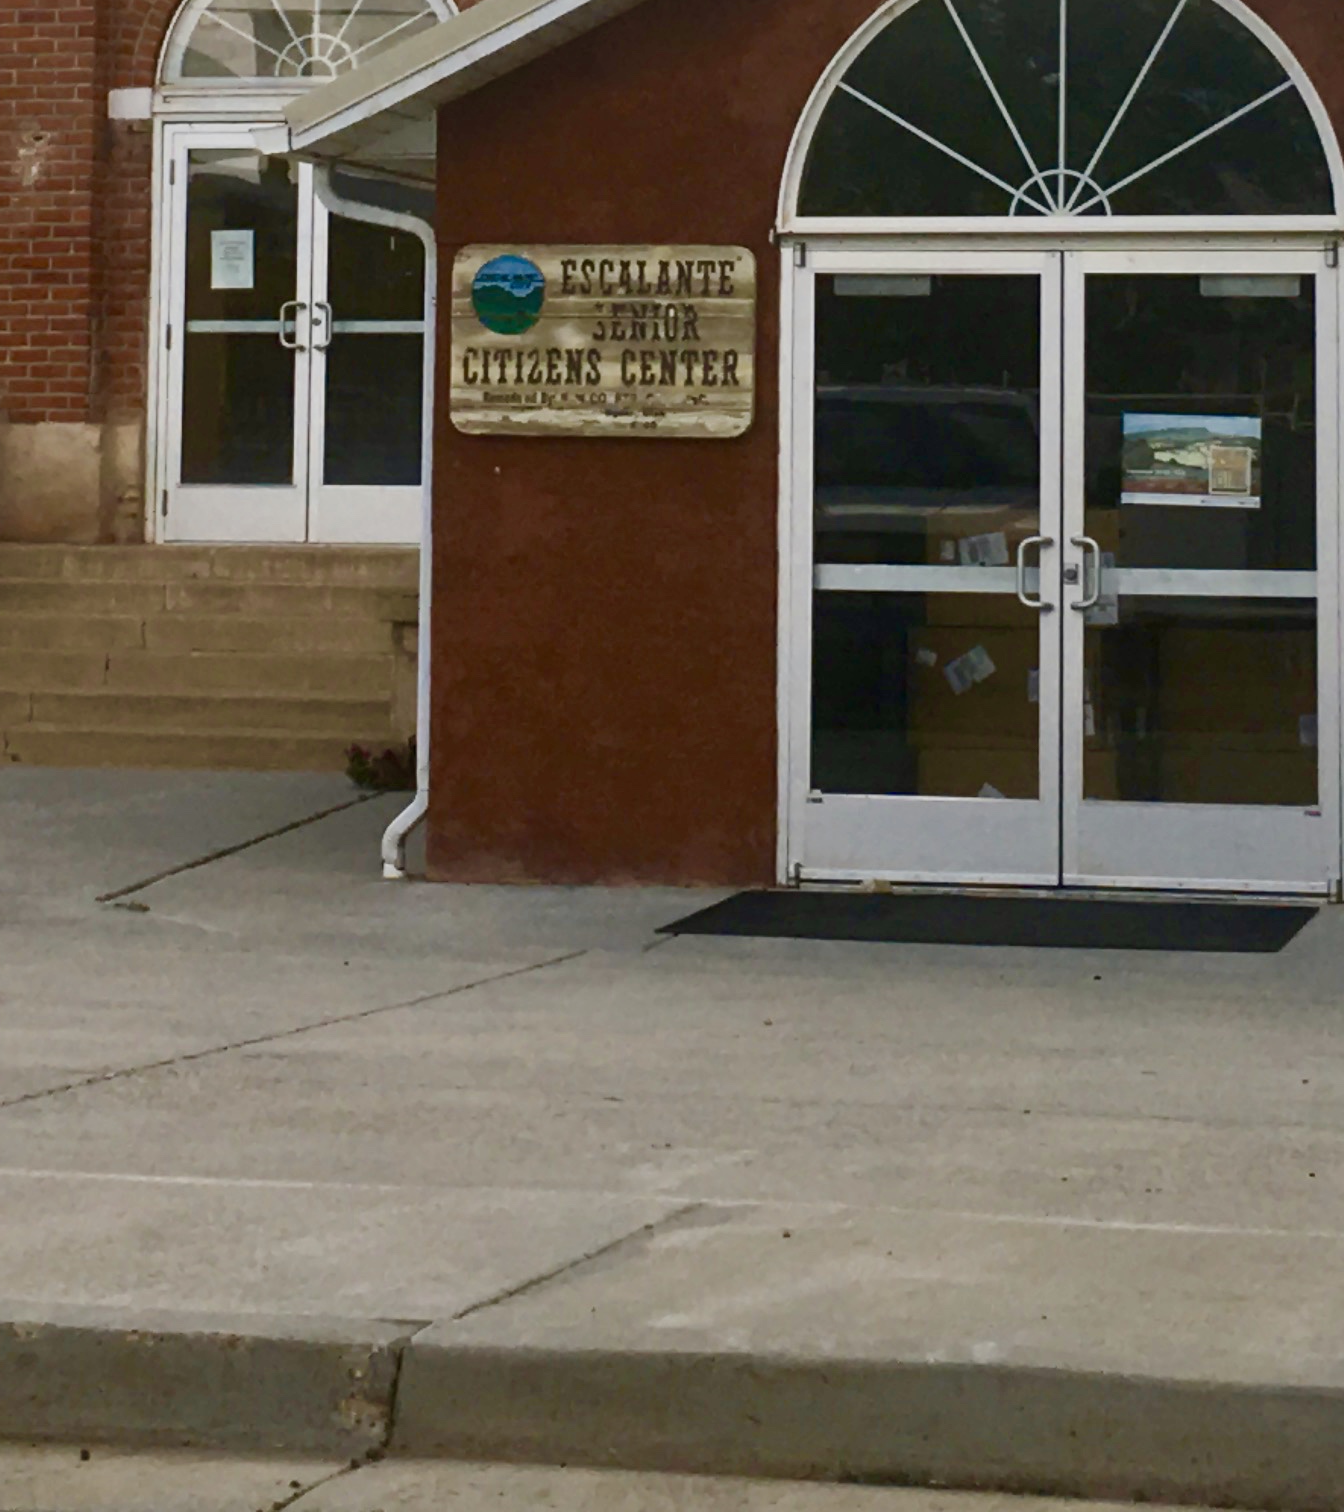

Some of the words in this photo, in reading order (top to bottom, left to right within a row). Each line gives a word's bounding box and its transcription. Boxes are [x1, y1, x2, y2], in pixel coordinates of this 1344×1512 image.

[559, 258, 736, 297] ESCALANTE
[591, 302, 701, 343] SENIOR
[461, 345, 603, 386] CITIZENS
[620, 348, 741, 388] CENTER
